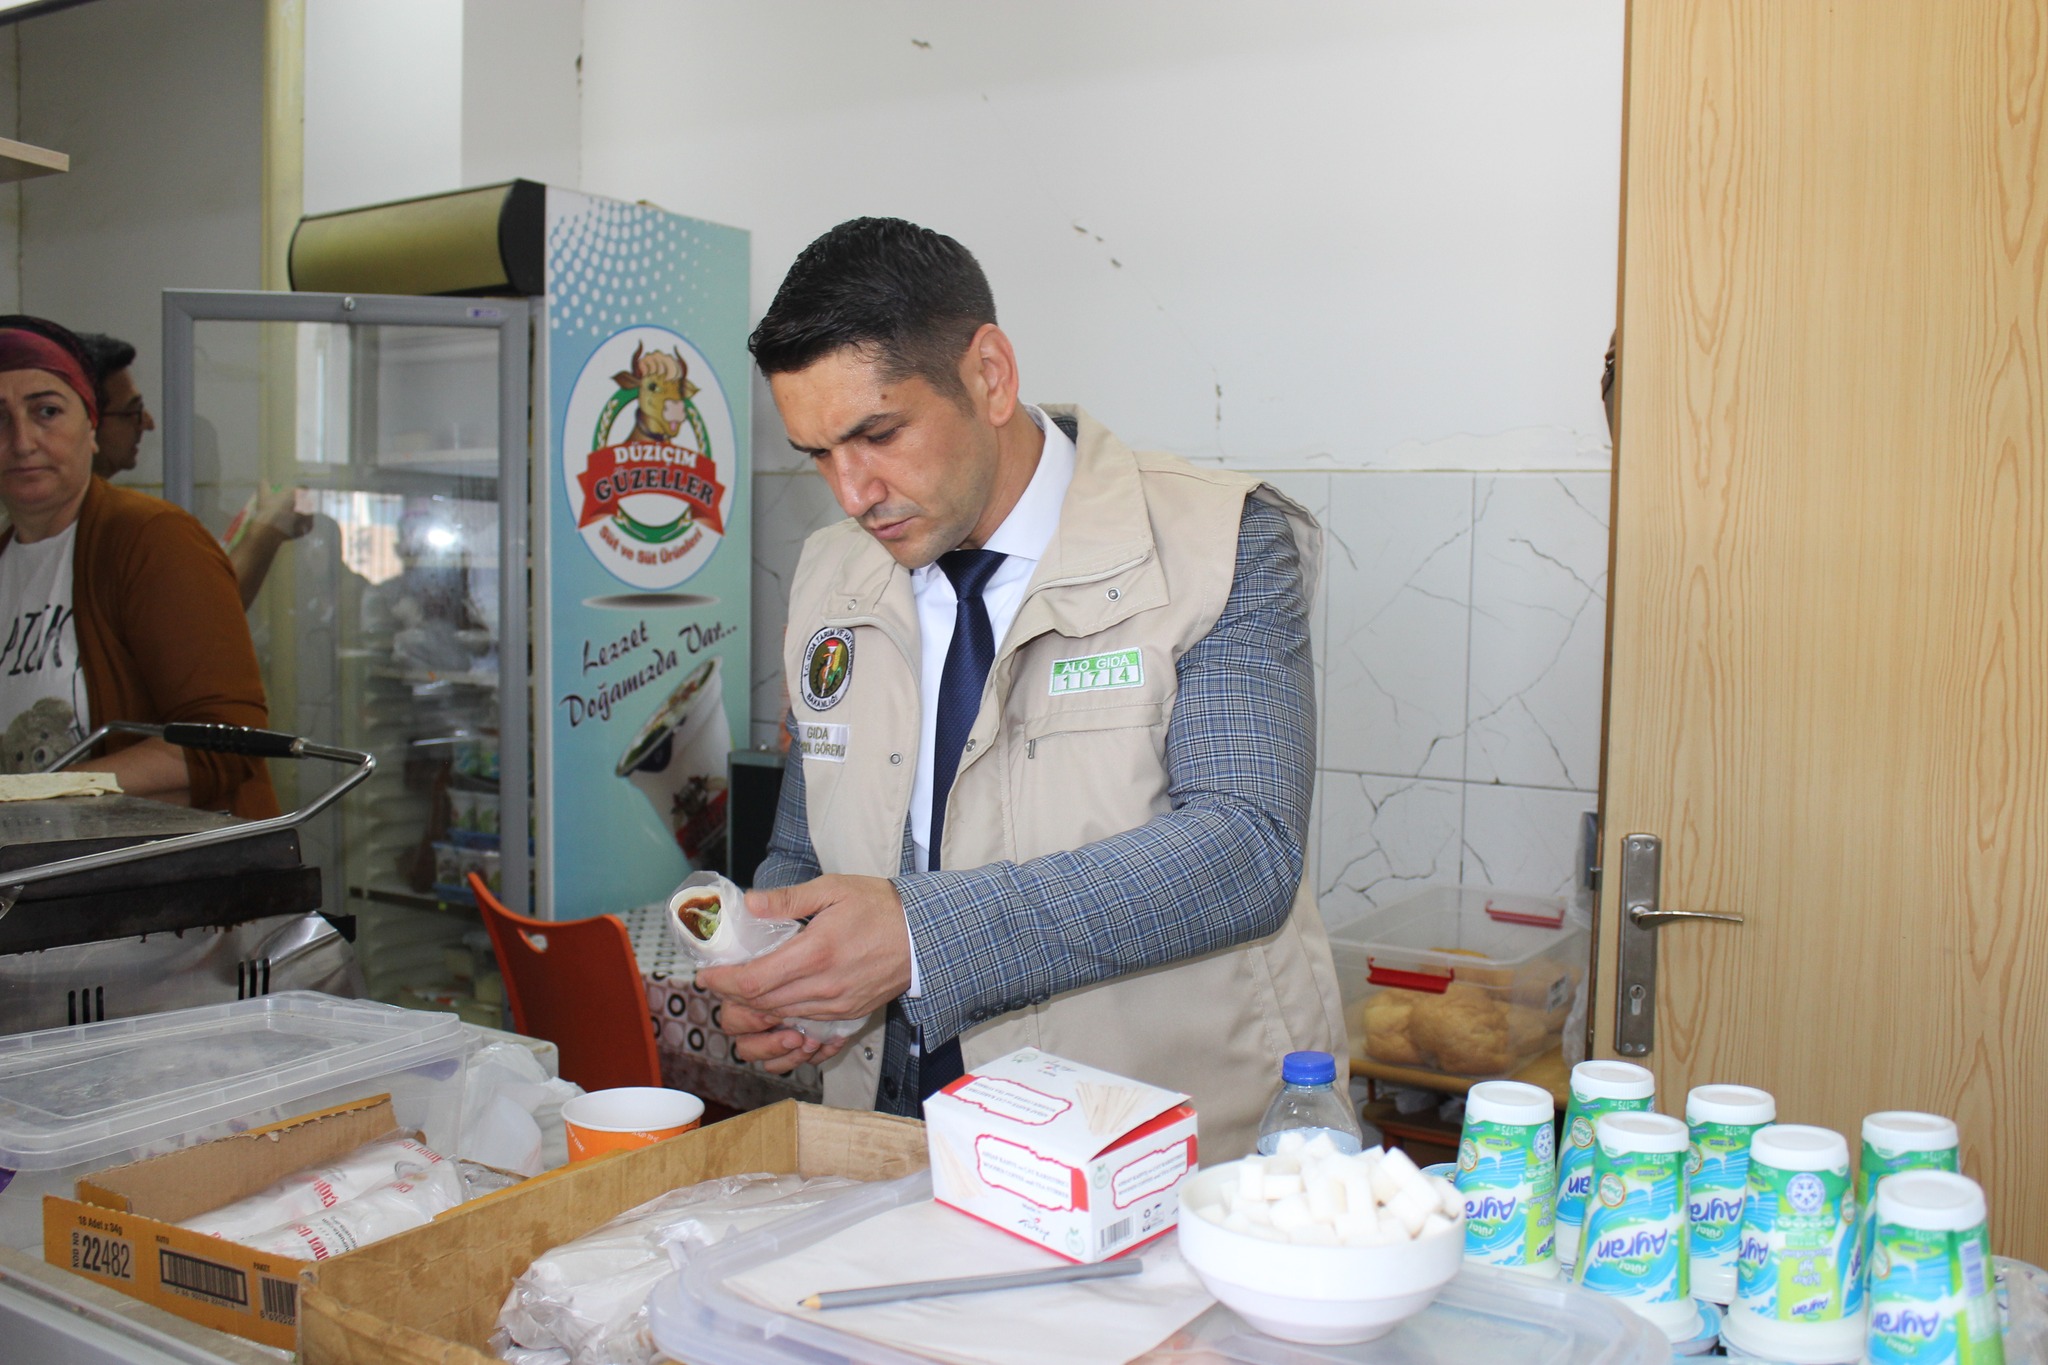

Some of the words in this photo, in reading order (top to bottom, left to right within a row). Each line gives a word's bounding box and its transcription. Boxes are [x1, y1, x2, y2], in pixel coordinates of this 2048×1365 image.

[593, 467, 715, 506] GÜZELLER
[620, 546, 635, 560] ve
[636, 548, 658, 565] Süt
[582, 619, 650, 677] Lezzet
[1061, 659, 1091, 675] ALO
[1095, 654, 1131, 670] GIDA
[559, 649, 678, 728] Doğamızda
[807, 726, 829, 740] GIDA
[1465, 1195, 1516, 1222] Ayra
[1689, 1197, 1743, 1224] Ayra
[82, 1234, 131, 1279] 22482
[1597, 1229, 1668, 1259] Ayran
